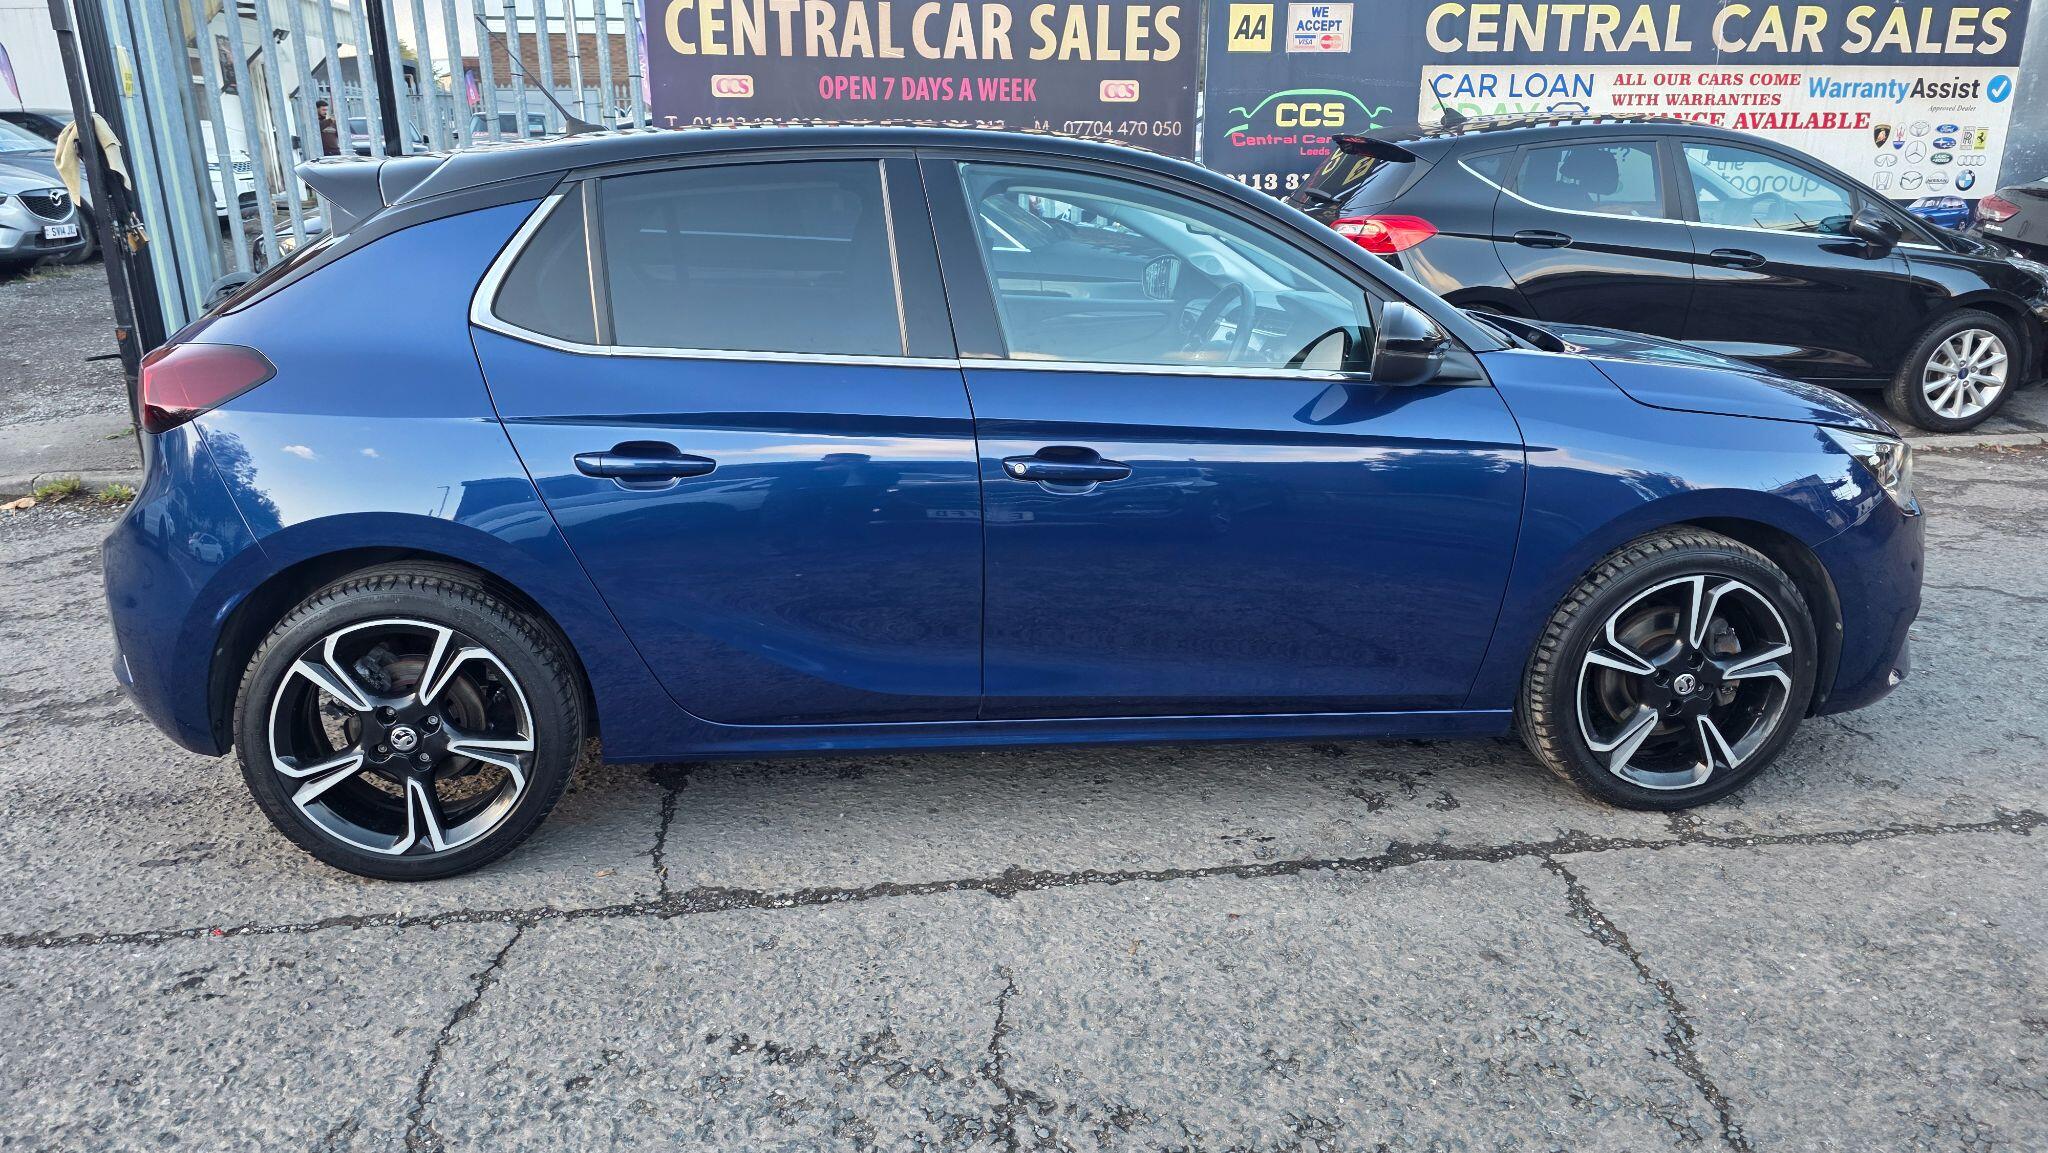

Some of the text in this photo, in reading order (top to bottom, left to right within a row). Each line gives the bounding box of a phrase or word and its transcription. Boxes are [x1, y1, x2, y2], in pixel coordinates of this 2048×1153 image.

[1311, 7, 1329, 18] WE
[665, 0, 1181, 61] CENTRAL CAR SALES
[1233, 14, 1267, 40] AA
[1296, 20, 1342, 31] ACCEPT
[1426, 3, 2012, 55] CENTRAL CAR SALES
[1433, 73, 1595, 98] CAR LOAN
[1613, 73, 1801, 86] ALL OUR CARS COME
[819, 75, 1037, 102] OPEN 7 DAYS A WEEK
[1612, 93, 1782, 106] WITH WARRANTIES
[1276, 102, 1345, 127] CCS
[1732, 112, 1871, 129] AVAILABLE
[1064, 120, 1113, 136] 07704
[1118, 120, 1148, 136] 470
[1153, 121, 1182, 136] 050
[1231, 132, 1297, 147] Central
[1302, 134, 1333, 144] Car
[1300, 147, 1331, 156] Leeds
